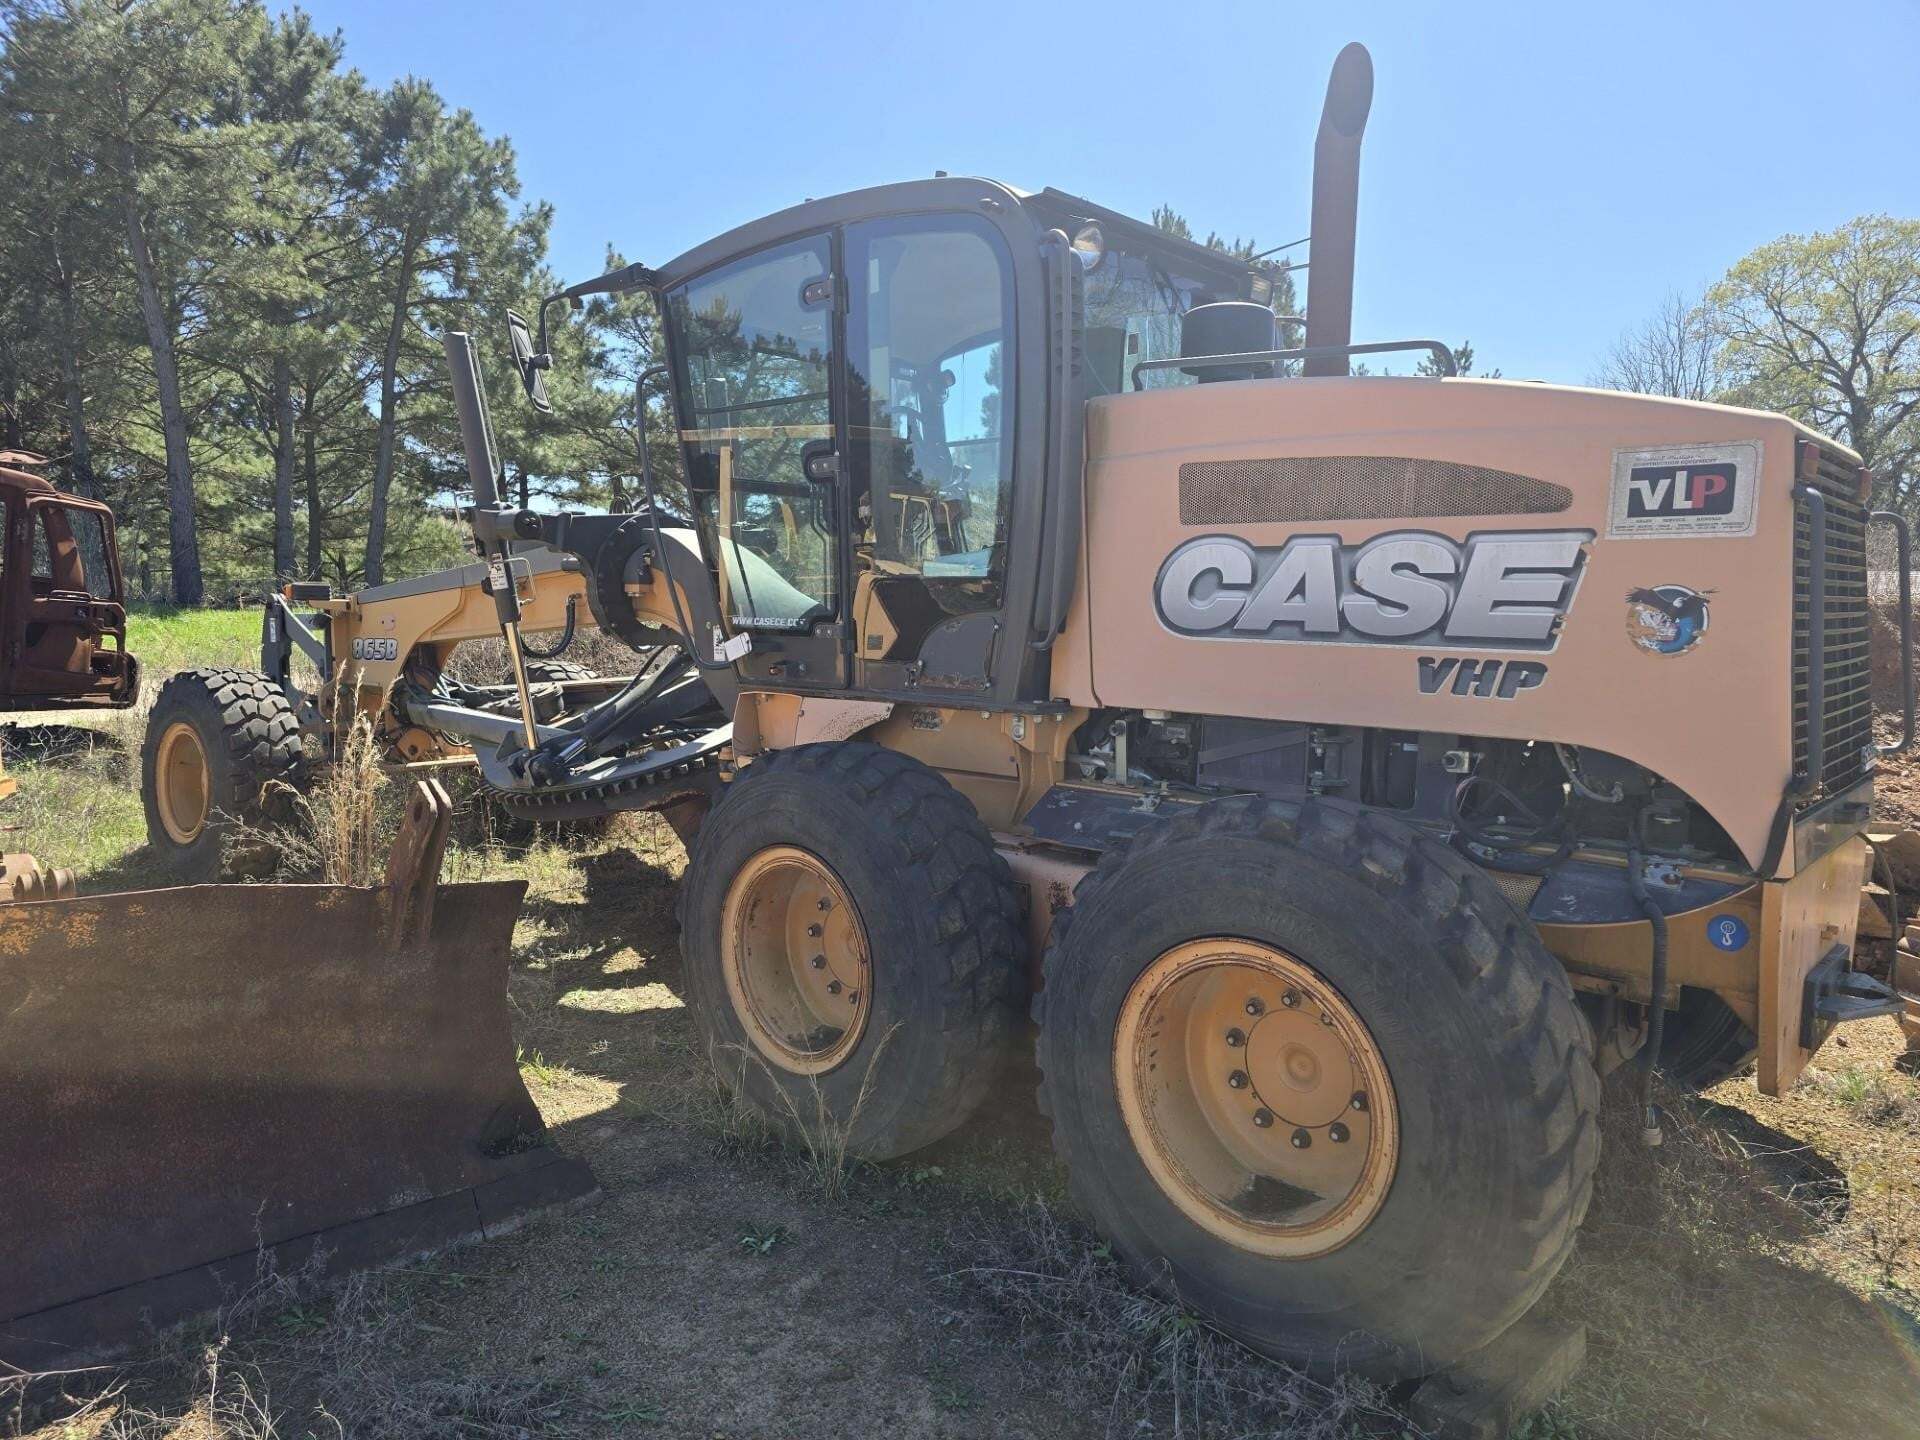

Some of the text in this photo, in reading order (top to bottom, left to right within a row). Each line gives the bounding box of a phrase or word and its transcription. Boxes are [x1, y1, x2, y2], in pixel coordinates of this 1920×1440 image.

[1629, 470, 1727, 511] VLP
[1158, 538, 1586, 642] CASE
[351, 637, 398, 661] 865B
[1416, 656, 1549, 700] VHP
